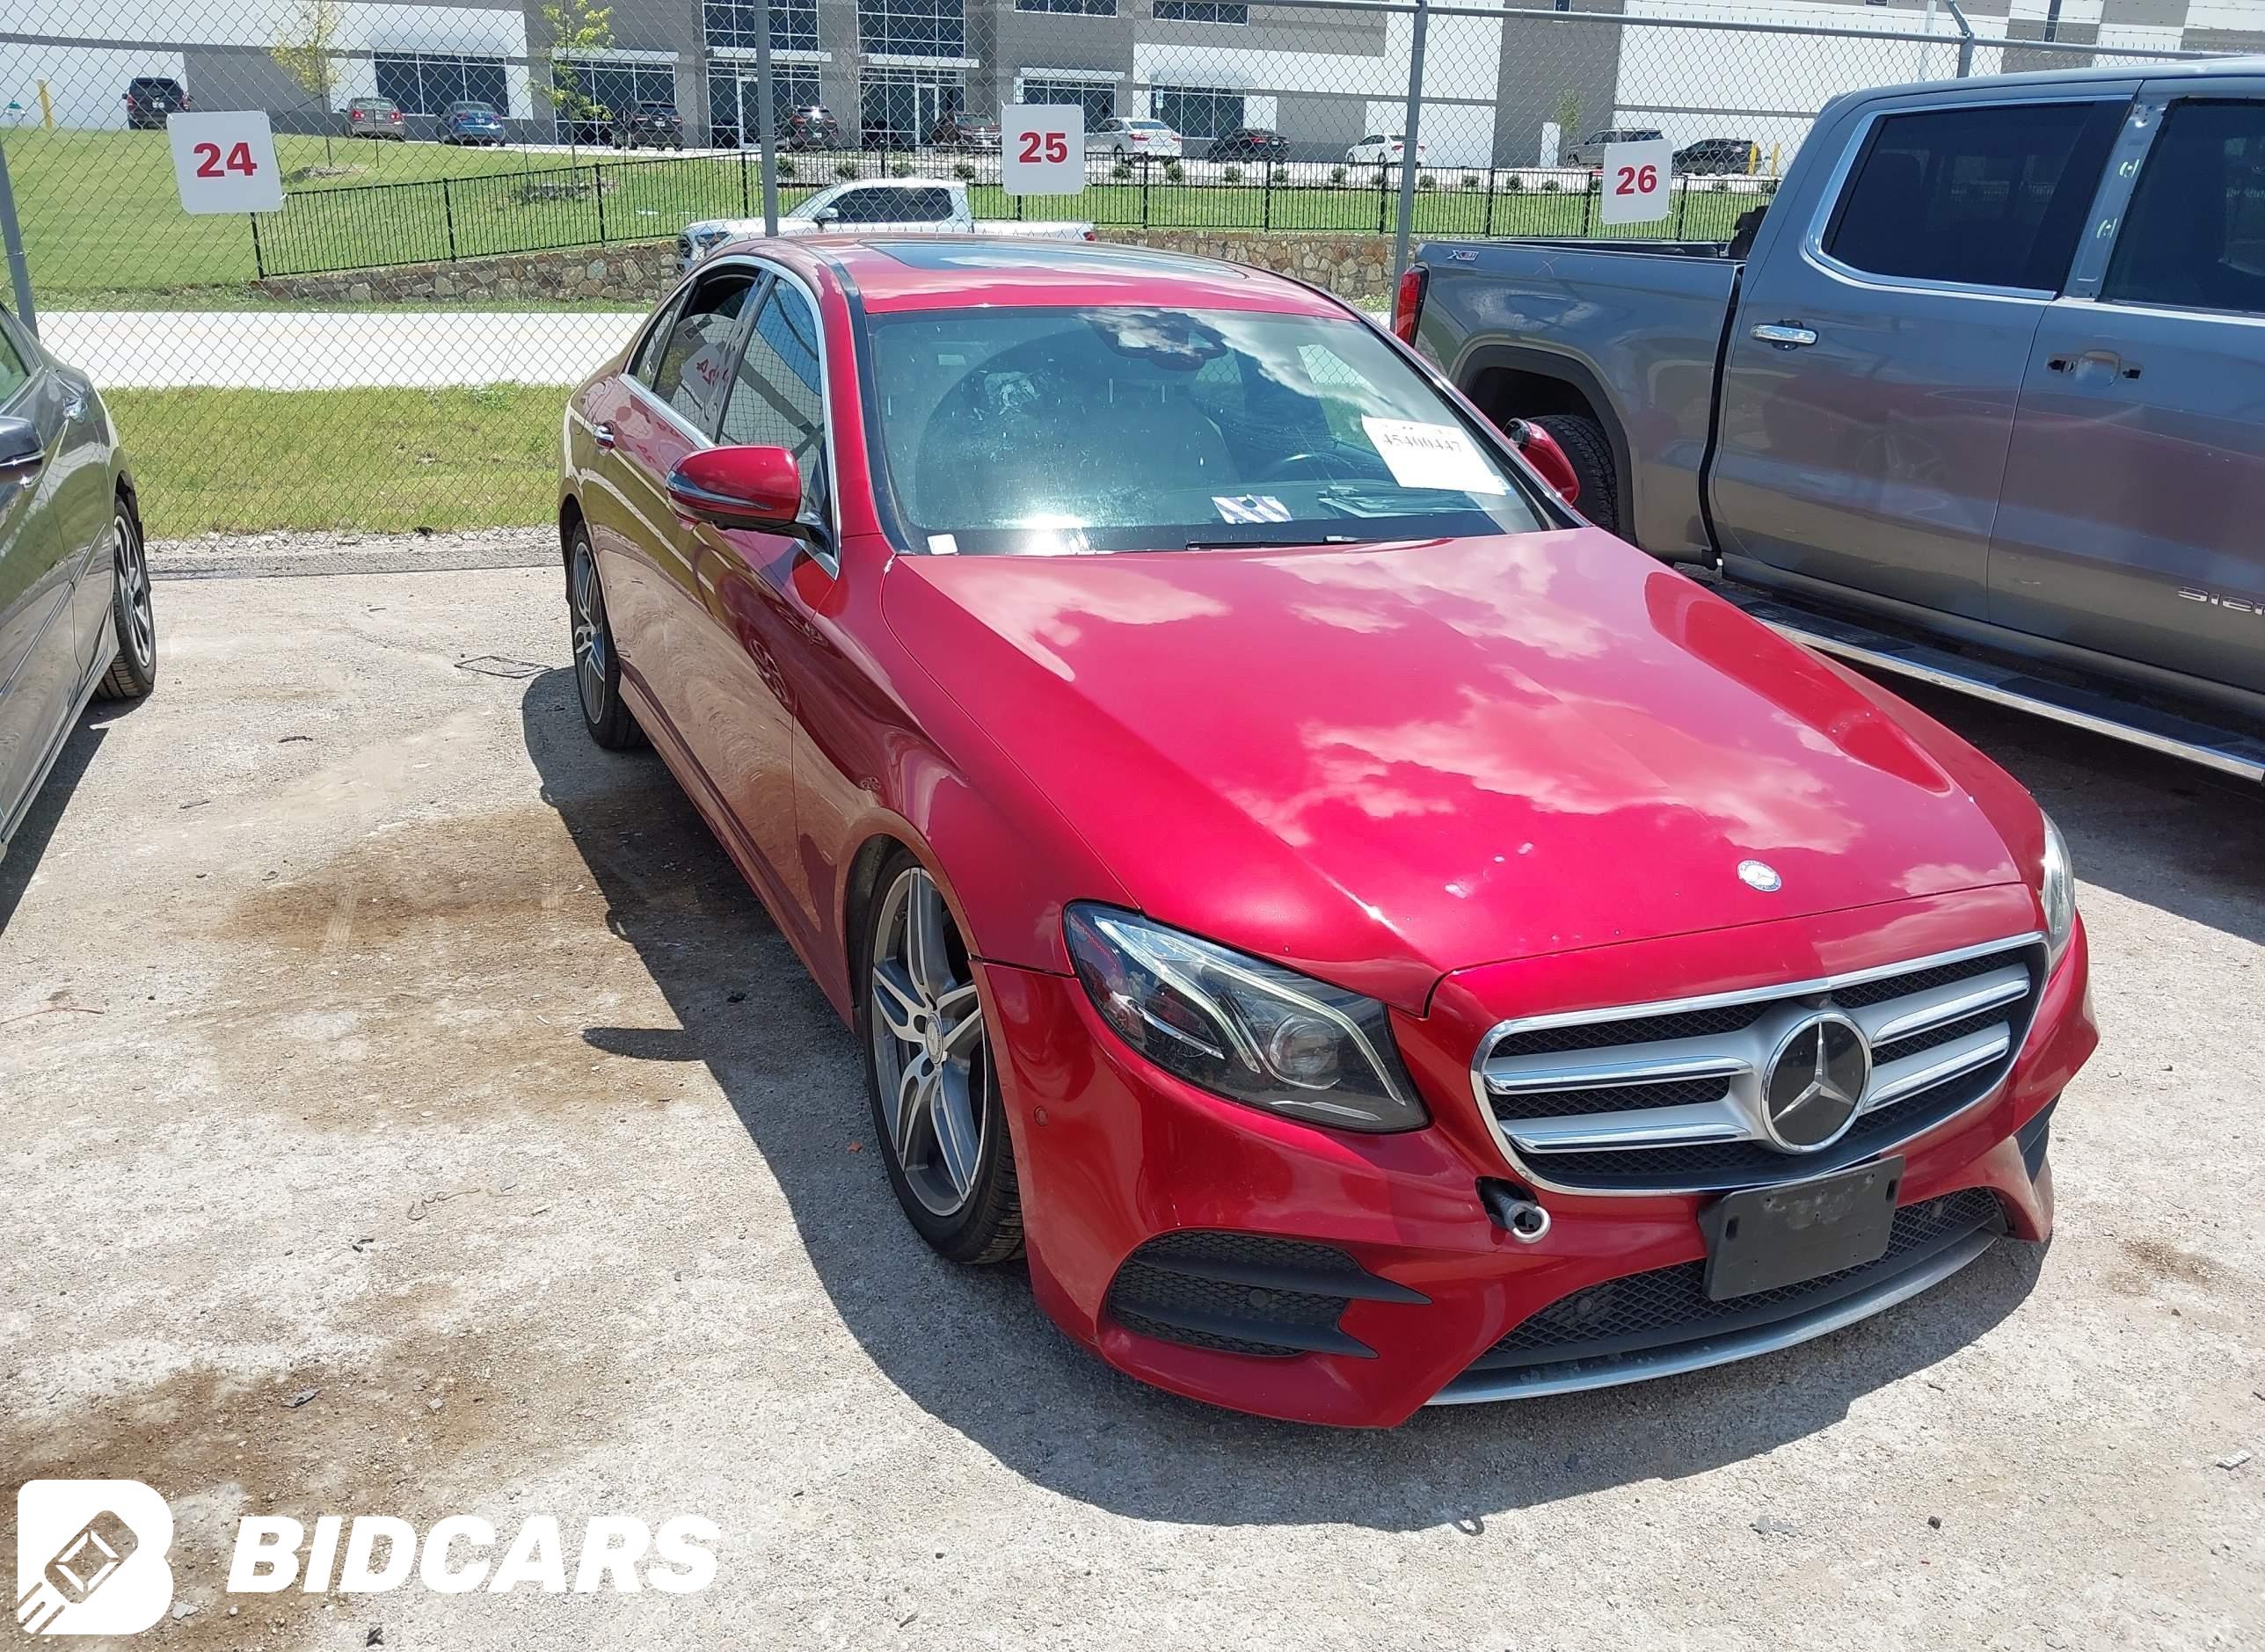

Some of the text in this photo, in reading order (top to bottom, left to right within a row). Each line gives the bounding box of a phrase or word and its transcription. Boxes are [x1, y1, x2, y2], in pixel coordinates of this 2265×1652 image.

[194, 142, 257, 178] 24
[1019, 132, 1067, 163] 25
[1616, 166, 1657, 195] 26
